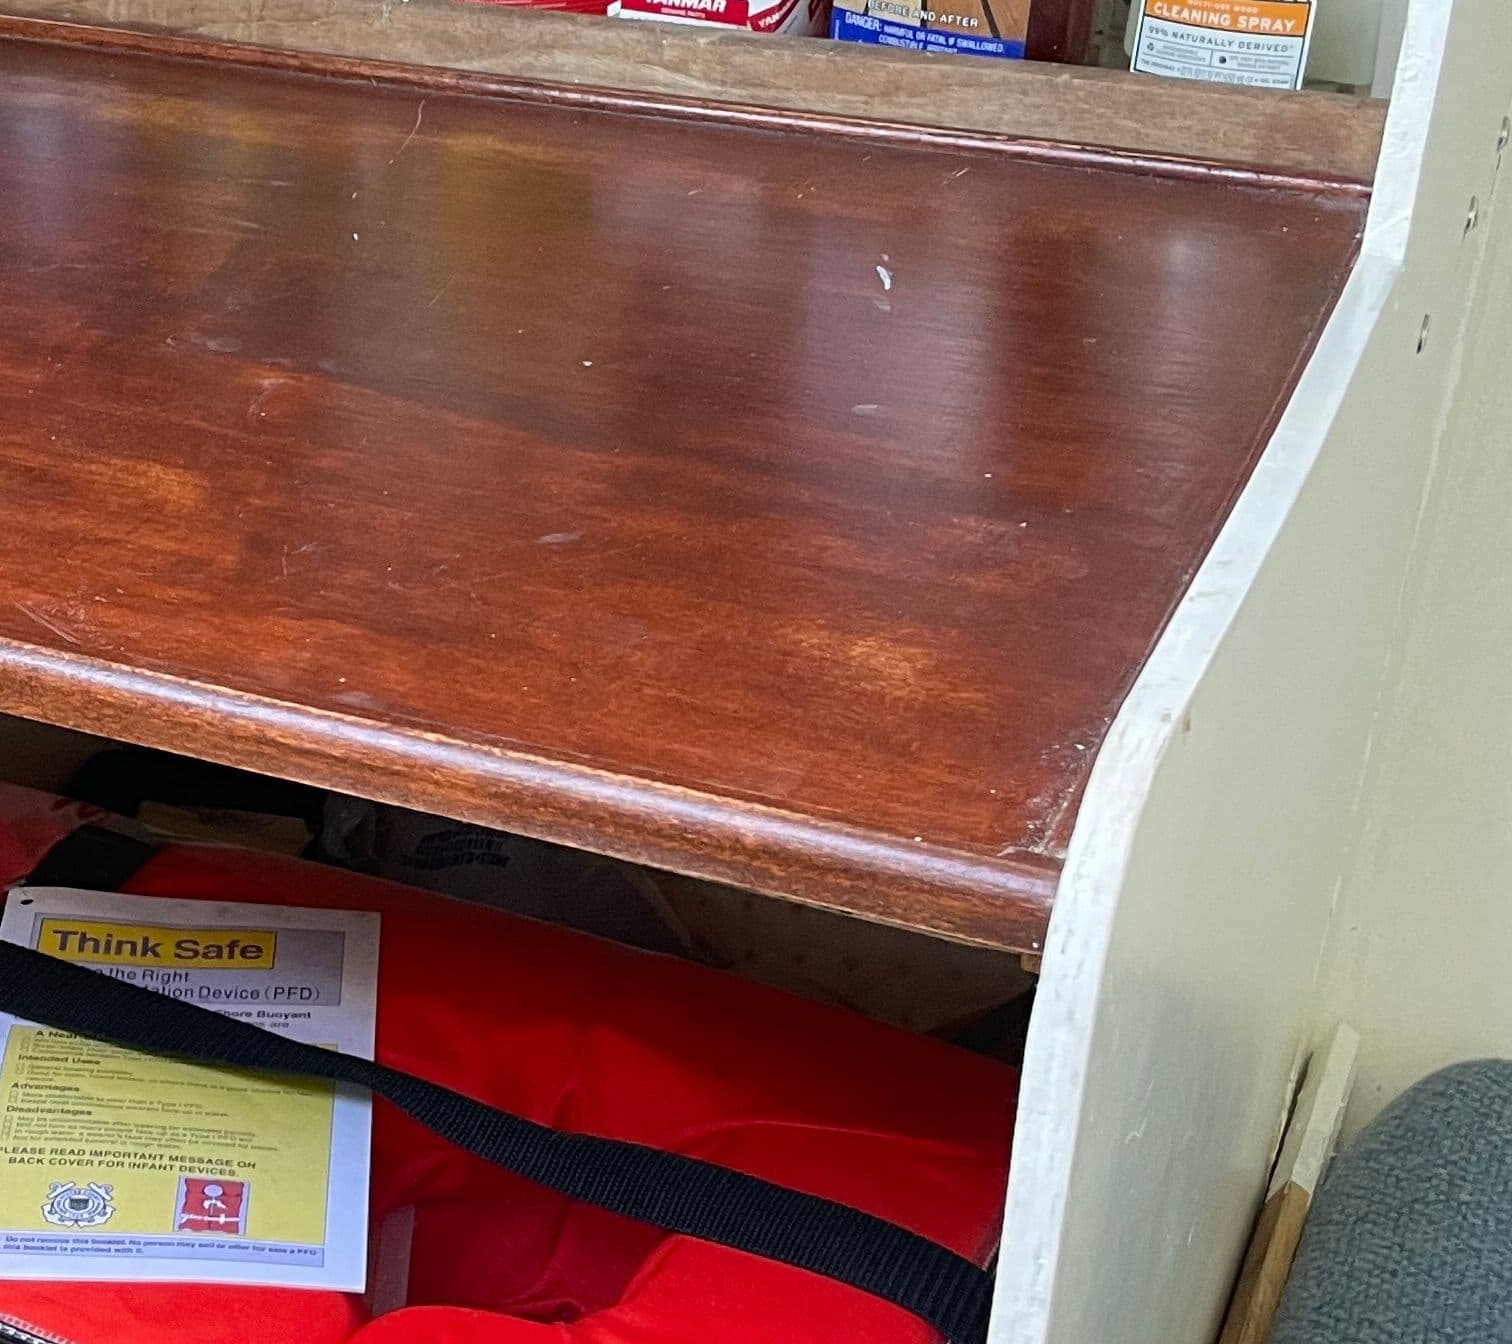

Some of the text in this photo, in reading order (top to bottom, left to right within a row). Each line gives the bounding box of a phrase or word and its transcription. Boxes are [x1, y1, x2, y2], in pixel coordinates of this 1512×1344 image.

[912, 10, 936, 22] AND
[940, 14, 978, 28] AFTER
[1154, 1, 1297, 33] CLEANING SPRAY
[845, 11, 882, 32] DANGER:
[883, 24, 914, 38] HARMFUL
[916, 30, 926, 40] OR
[926, 32, 947, 46] FATAL
[1148, 25, 1169, 38] 99%
[1172, 30, 1235, 49] NATURALLY
[52, 930, 264, 960] Think Safe
[142, 968, 190, 984] Right
[198, 986, 260, 1000] Device
[264, 986, 321, 1002] (PFD)
[257, 1010, 312, 1020] Buoyant
[18, 1054, 101, 1066] Intended Uses
[11, 1082, 80, 1092] Advantages
[6, 1106, 93, 1116] Disadvantages
[8, 1156, 45, 1166] BACK
[48, 1158, 94, 1168] COVER
[98, 1159, 126, 1169] FOR
[128, 1162, 176, 1172] INFANT
[50, 1148, 86, 1157] READ
[89, 1148, 164, 1162] IMPORTANT
[168, 1155, 234, 1167] MESSAGE
[238, 1160, 256, 1170] ON
